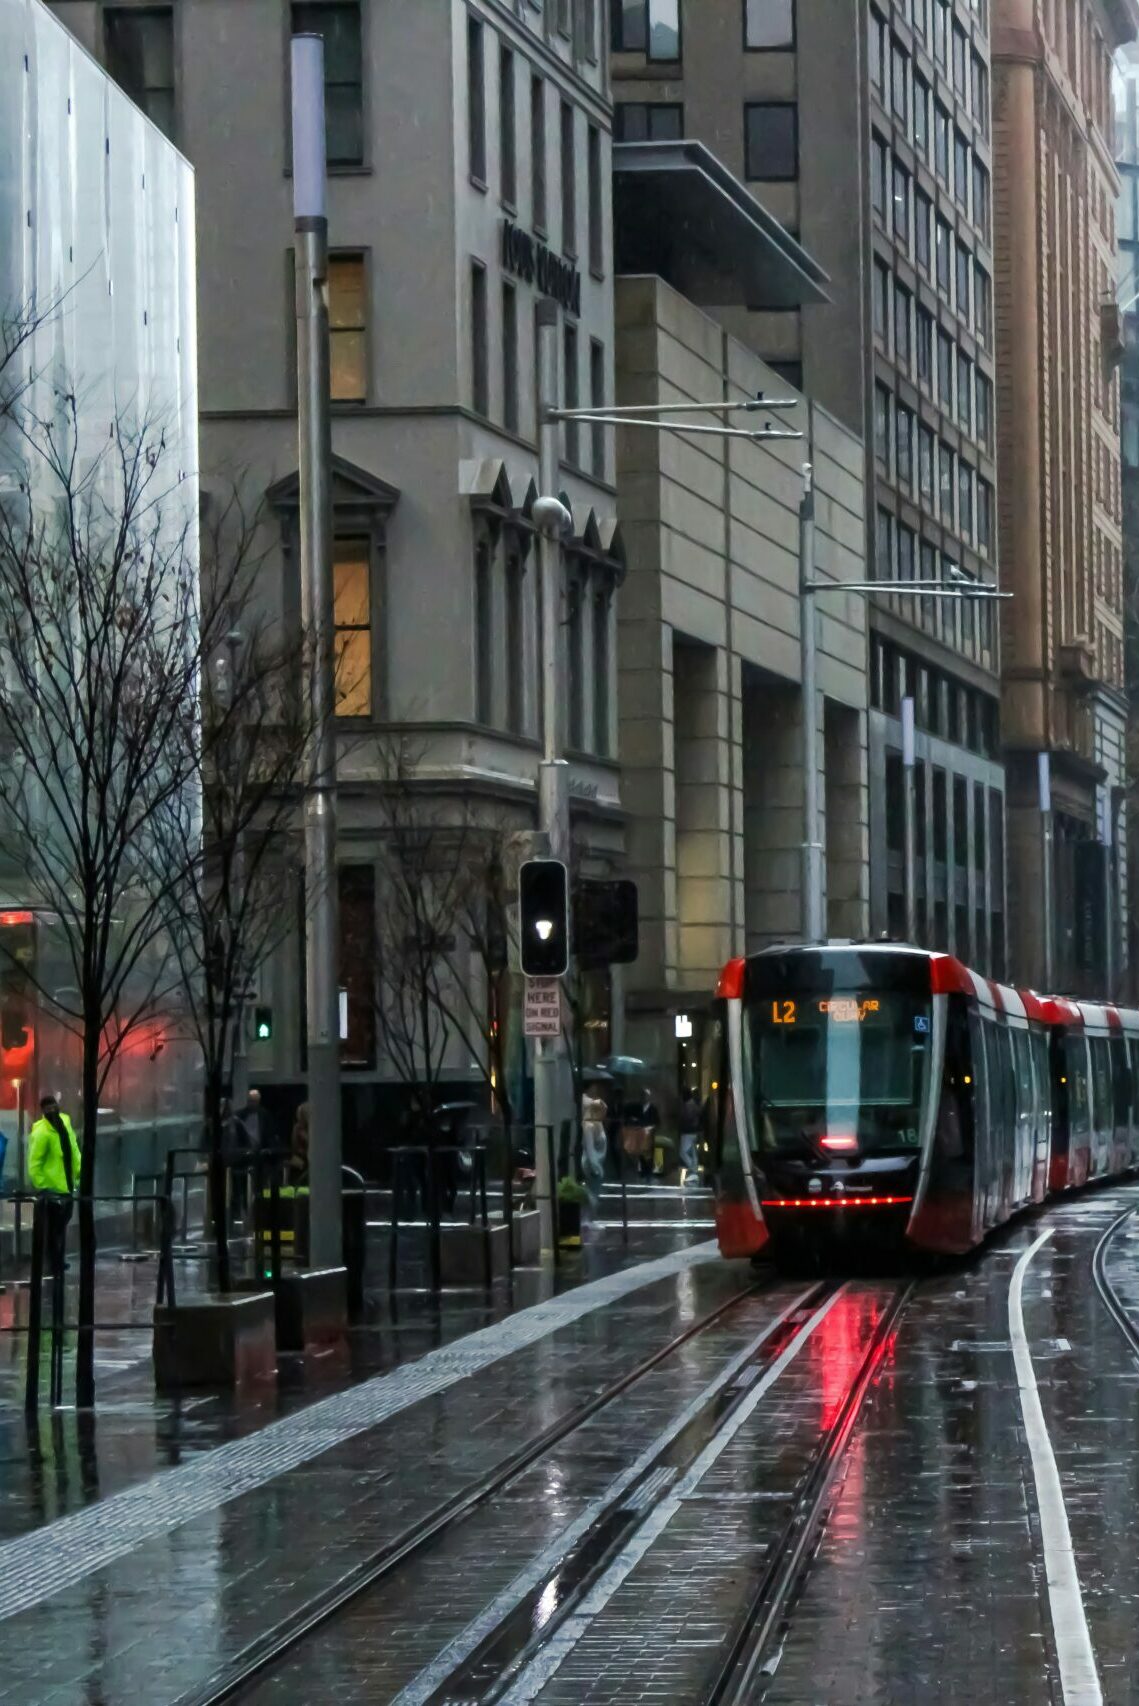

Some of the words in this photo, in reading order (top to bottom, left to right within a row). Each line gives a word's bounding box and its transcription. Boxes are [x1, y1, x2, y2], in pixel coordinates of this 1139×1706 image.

[528, 992, 557, 1004] HERE
[526, 1008, 539, 1018] ON
[541, 1008, 559, 1018] RED
[772, 1001, 796, 1023] L2
[819, 1000, 880, 1012] CIRCULAR
[526, 1022, 558, 1033] SIGNAL
